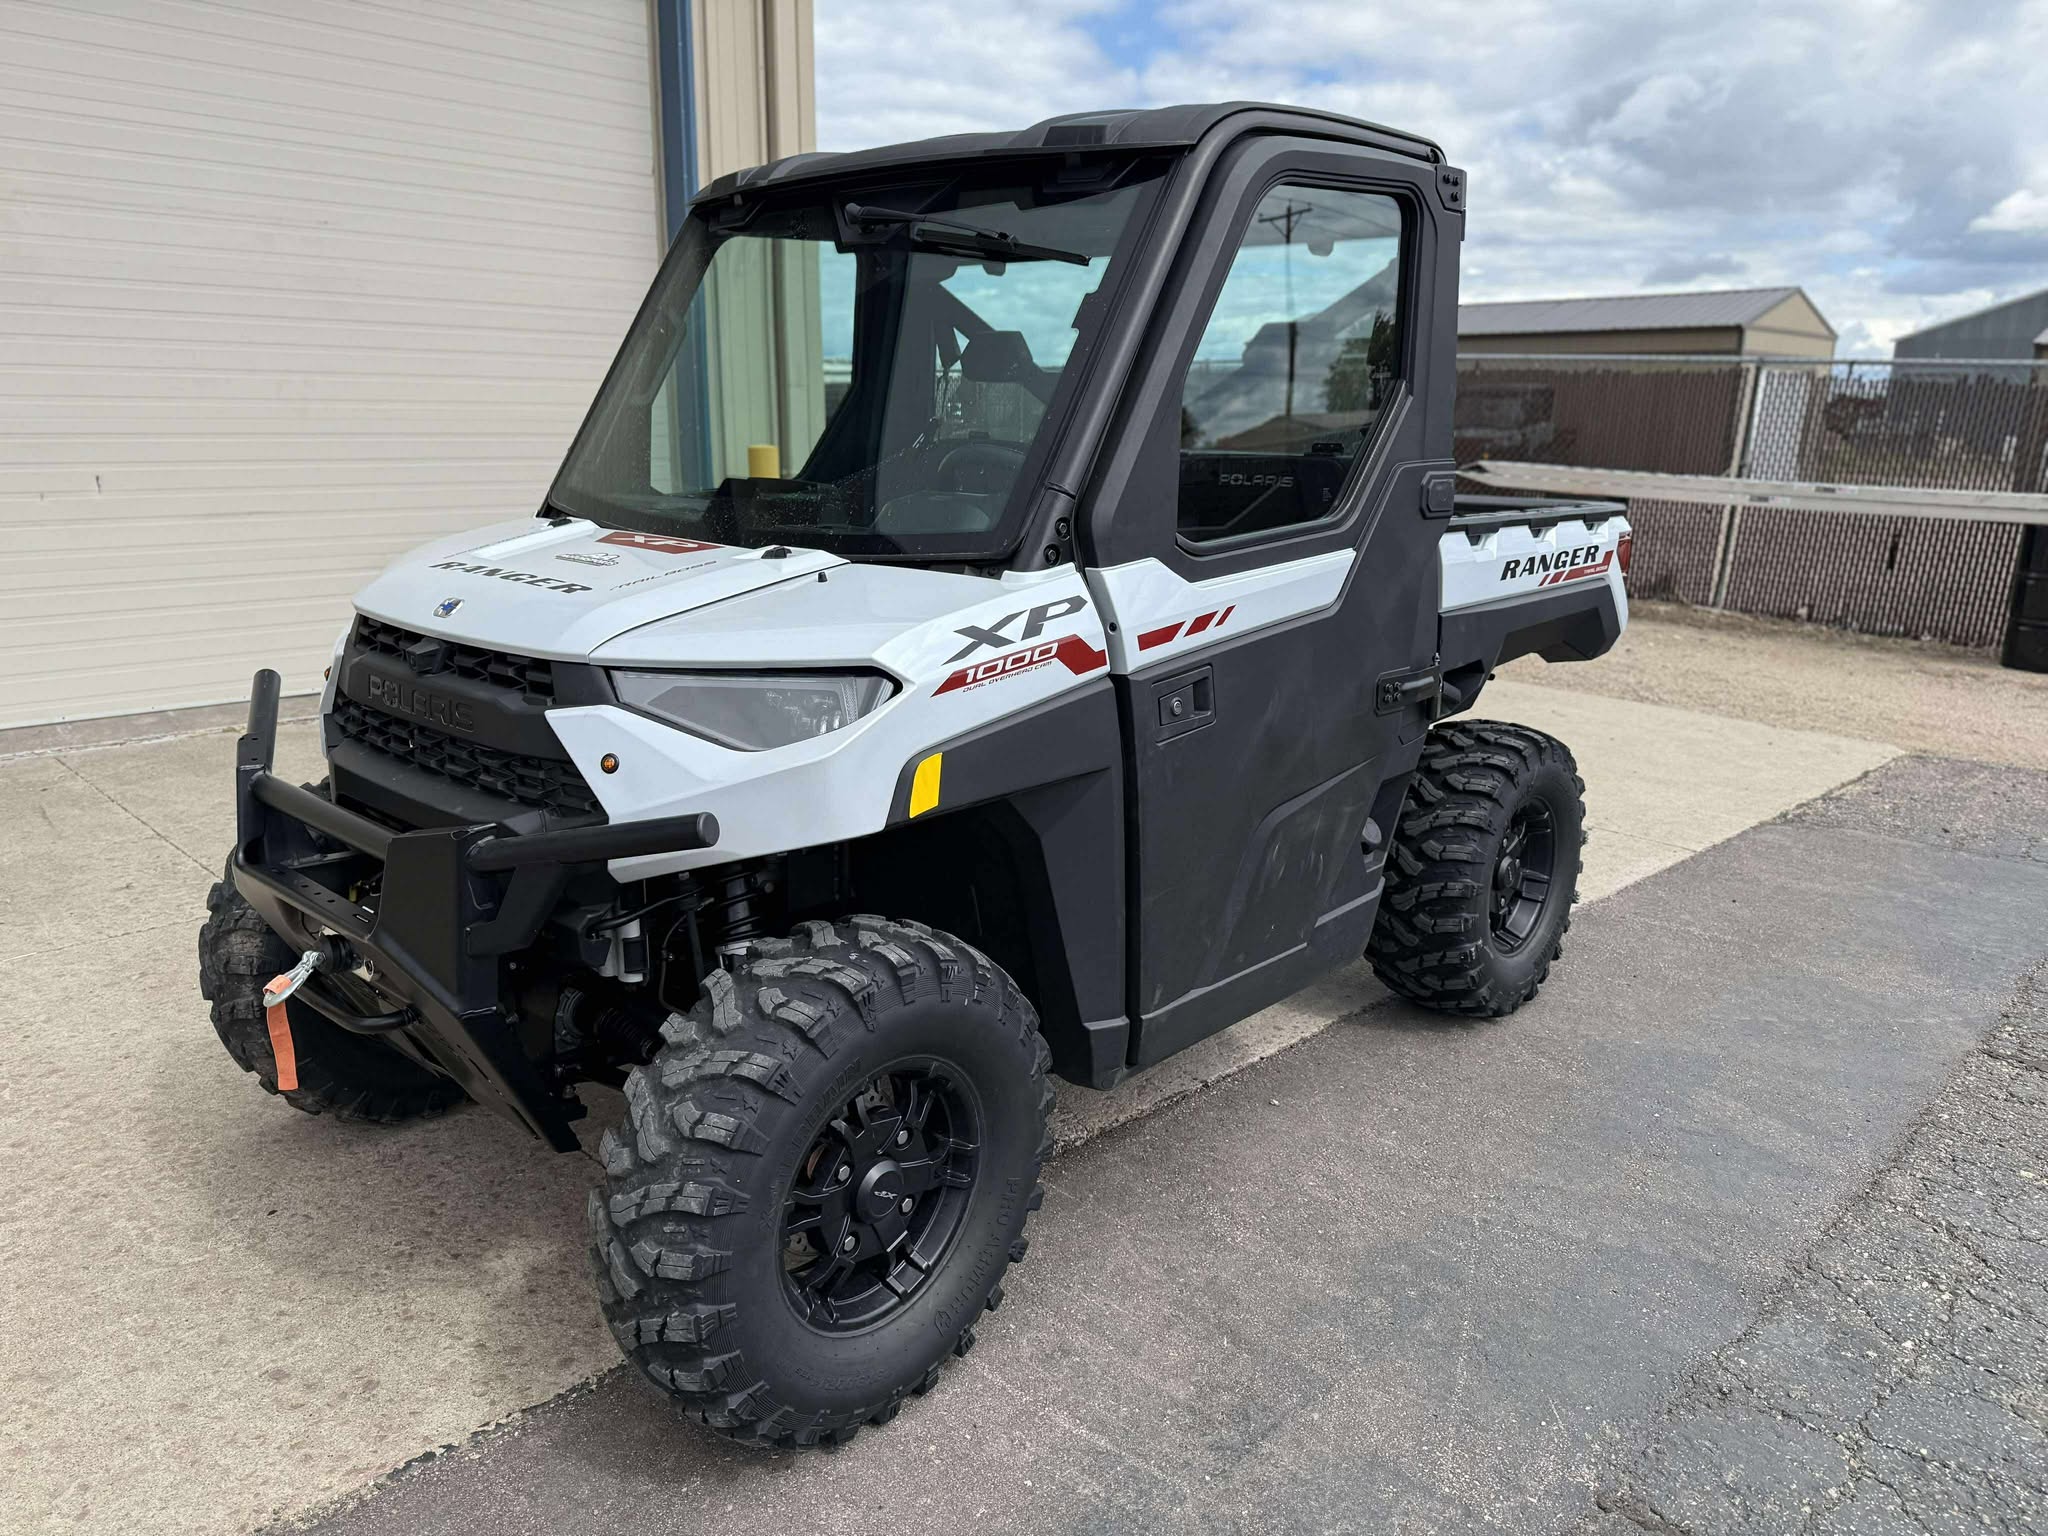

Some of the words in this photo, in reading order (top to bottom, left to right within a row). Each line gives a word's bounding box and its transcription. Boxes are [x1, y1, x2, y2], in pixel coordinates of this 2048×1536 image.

[1218, 473, 1295, 488] POLARIS
[429, 561, 593, 594] RANGER
[1500, 545, 1600, 581] RANGER
[941, 595, 1088, 666] XP
[962, 682, 986, 693] DUAL
[988, 667, 1033, 685] OVERHEAD
[1034, 661, 1053, 670] CAM
[965, 642, 1059, 683] 1000
[368, 674, 474, 733] POLARIS
